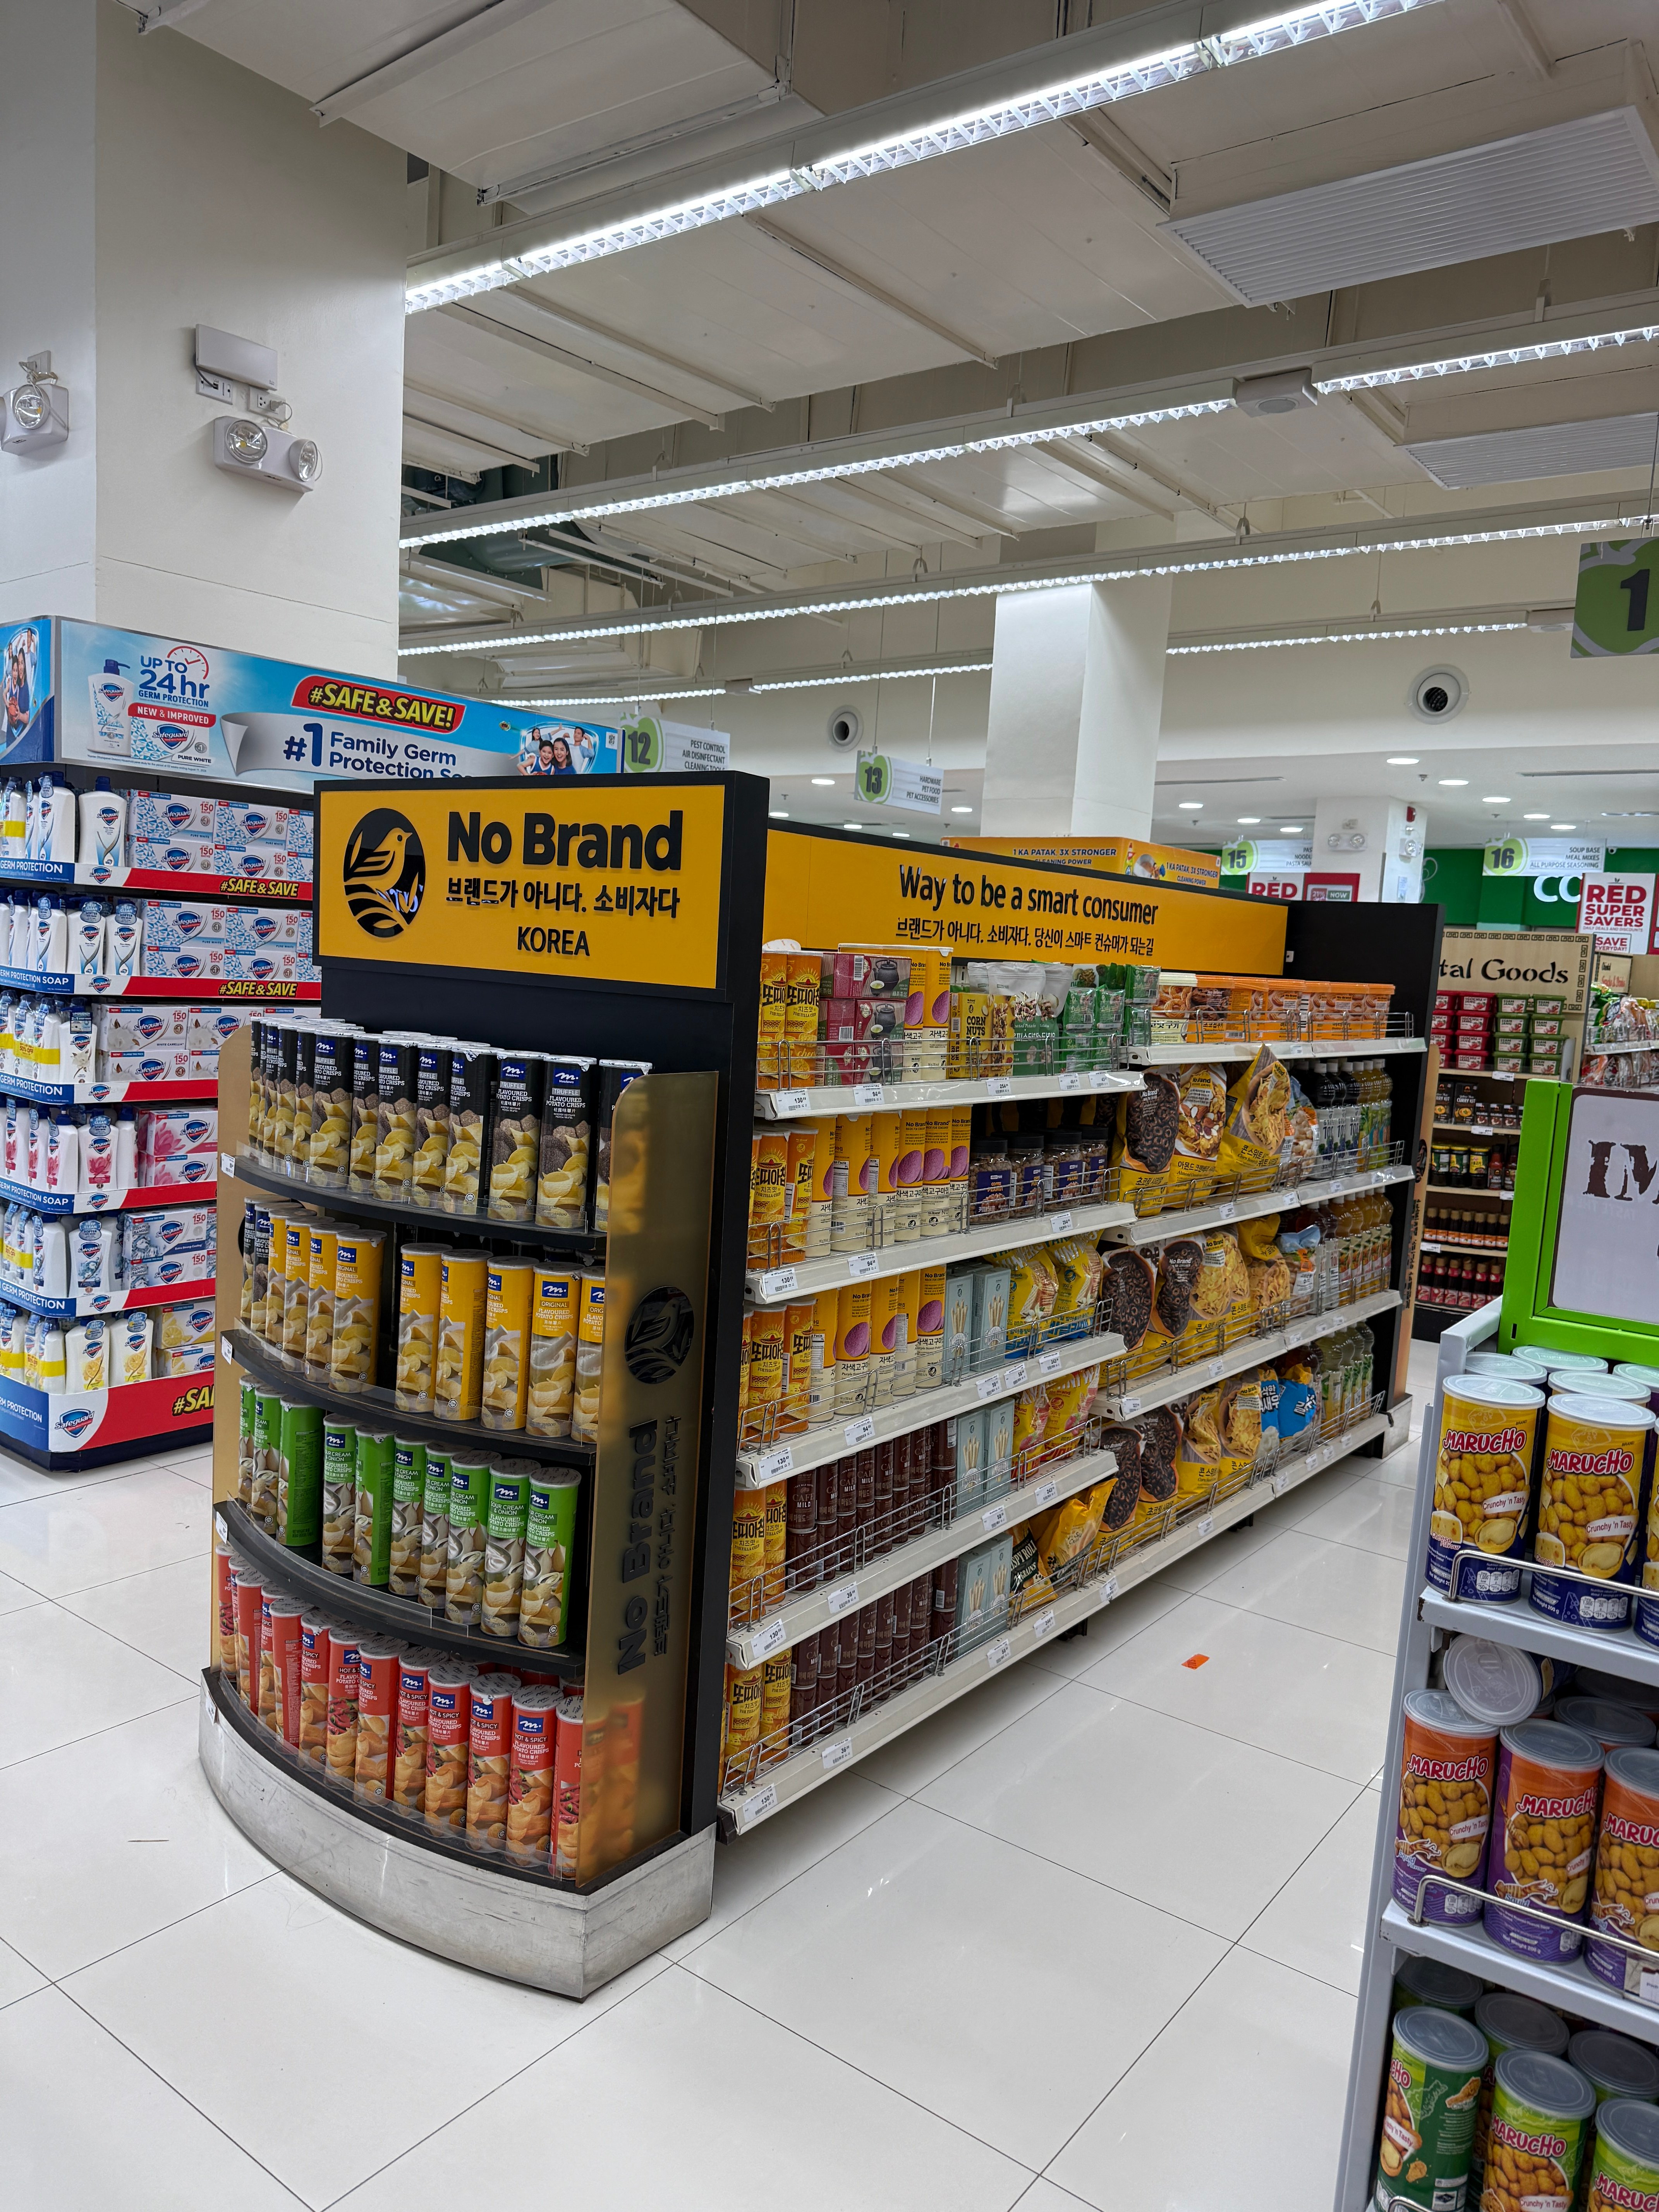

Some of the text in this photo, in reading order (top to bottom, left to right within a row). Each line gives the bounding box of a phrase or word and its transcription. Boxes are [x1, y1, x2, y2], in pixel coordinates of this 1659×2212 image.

[140, 656, 187, 673] UP TO
[139, 669, 210, 699] 24 hr
[139, 690, 161, 700] GERM
[163, 694, 208, 707] PROTECTION
[137, 706, 157, 716] NEW
[167, 711, 209, 724] IMPROVED
[152, 730, 189, 740] Safeguard
[283, 723, 323, 767] #1
[331, 731, 456, 766] Family Germ
[628, 731, 651, 765] 12
[691, 740, 725, 754] PEST CONTROL
[330, 751, 433, 779] Protection
[682, 750, 725, 764] AIR DISINFECTANT
[685, 761, 709, 771] CLEANING
[865, 766, 882, 794] 13
[920, 776, 941, 786] HARDWARE
[915, 793, 938, 803] ACCESSORIES
[161, 808, 191, 819] Safeguard
[200, 803, 213, 812] 150
[447, 810, 683, 871] No Brand
[0, 860, 63, 874] GERM PROTECTION
[1228, 850, 1246, 869] 15
[1492, 848, 1515, 869] 16
[1197, 868, 1218, 878] STRONGER
[446, 878, 680, 919] 브랜드가 아니다. 소비자다
[899, 864, 1158, 925] Way to be a smart consumer
[1252, 882, 1297, 898] RED
[1586, 884, 1646, 904] RED
[211, 910, 225, 918] 150
[1585, 904, 1645, 917] SUPER
[1584, 916, 1643, 927] SAVERS
[517, 926, 589, 957] KOREA
[896, 917, 1154, 956] 브랜드가 아니다. 소비자다. 당신이 스마트 컨슈머가 되는길
[1596, 937, 1628, 946] SAVE
[0, 969, 9, 977] ERM
[10, 972, 40, 983] PROTECTION
[42, 977, 69, 985] SOAP
[1481, 958, 1568, 984] Goods
[966, 1017, 986, 1026] CORN
[966, 1026, 986, 1036] NUTS
[55, 1411, 94, 1430] Safeguard
[1443, 1427, 1527, 1454] MARUCHO
[1547, 1448, 1634, 1475] MARUCHO
[1586, 1521, 1612, 1534] Crunchy
[1619, 1520, 1635, 1530] Tasty
[1432, 1532, 1452, 1542] Cheese
[618, 1418, 658, 1675] No Brand
[1537, 1598, 1547, 1608] Weight
[1407, 1754, 1489, 1781] MARUCHO
[1399, 1850, 1416, 1864] Squid
[1492, 2115, 1567, 2158] MARUCHO
[1520, 2198, 1543, 2209] Crunchy
[1552, 2200, 1567, 2210] Tasty
